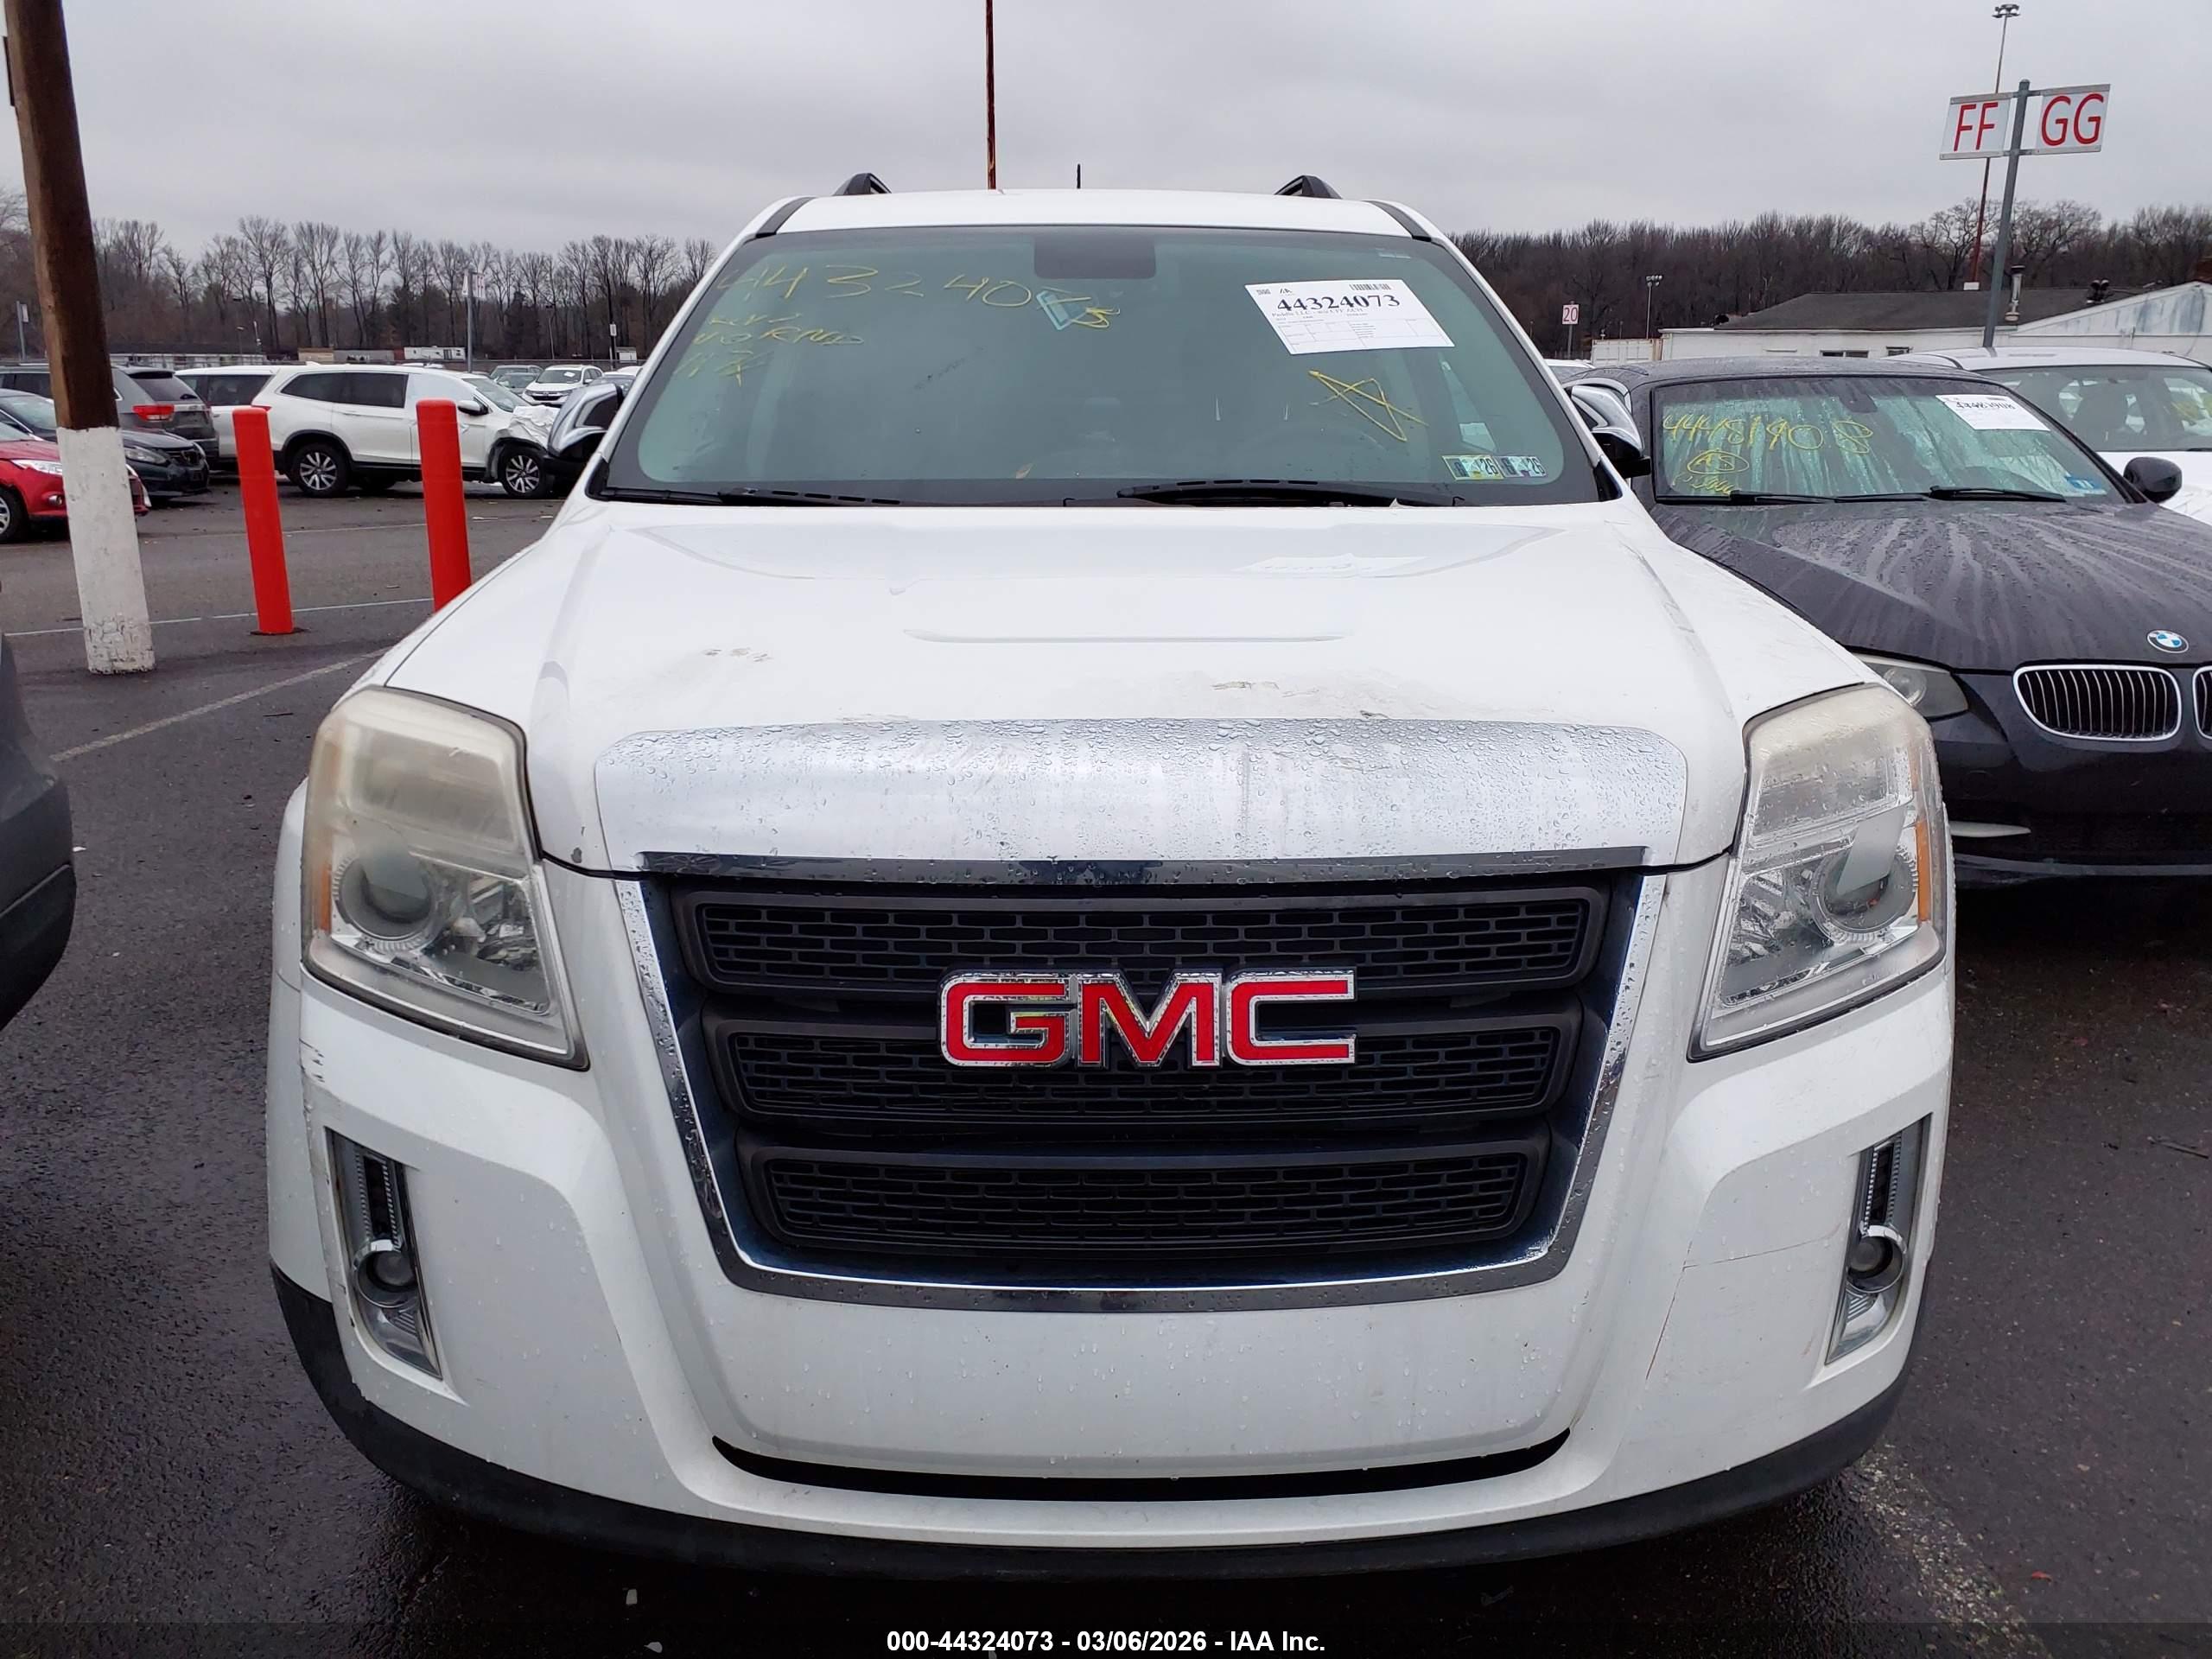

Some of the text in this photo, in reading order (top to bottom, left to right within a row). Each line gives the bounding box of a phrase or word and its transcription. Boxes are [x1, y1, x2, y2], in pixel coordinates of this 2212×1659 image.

[1953, 101, 1999, 152] FF
[2040, 92, 2105, 147] GG
[1276, 294, 1401, 312] 44324073
[1563, 307, 1578, 322] 20
[940, 969, 1356, 1068] GMC
